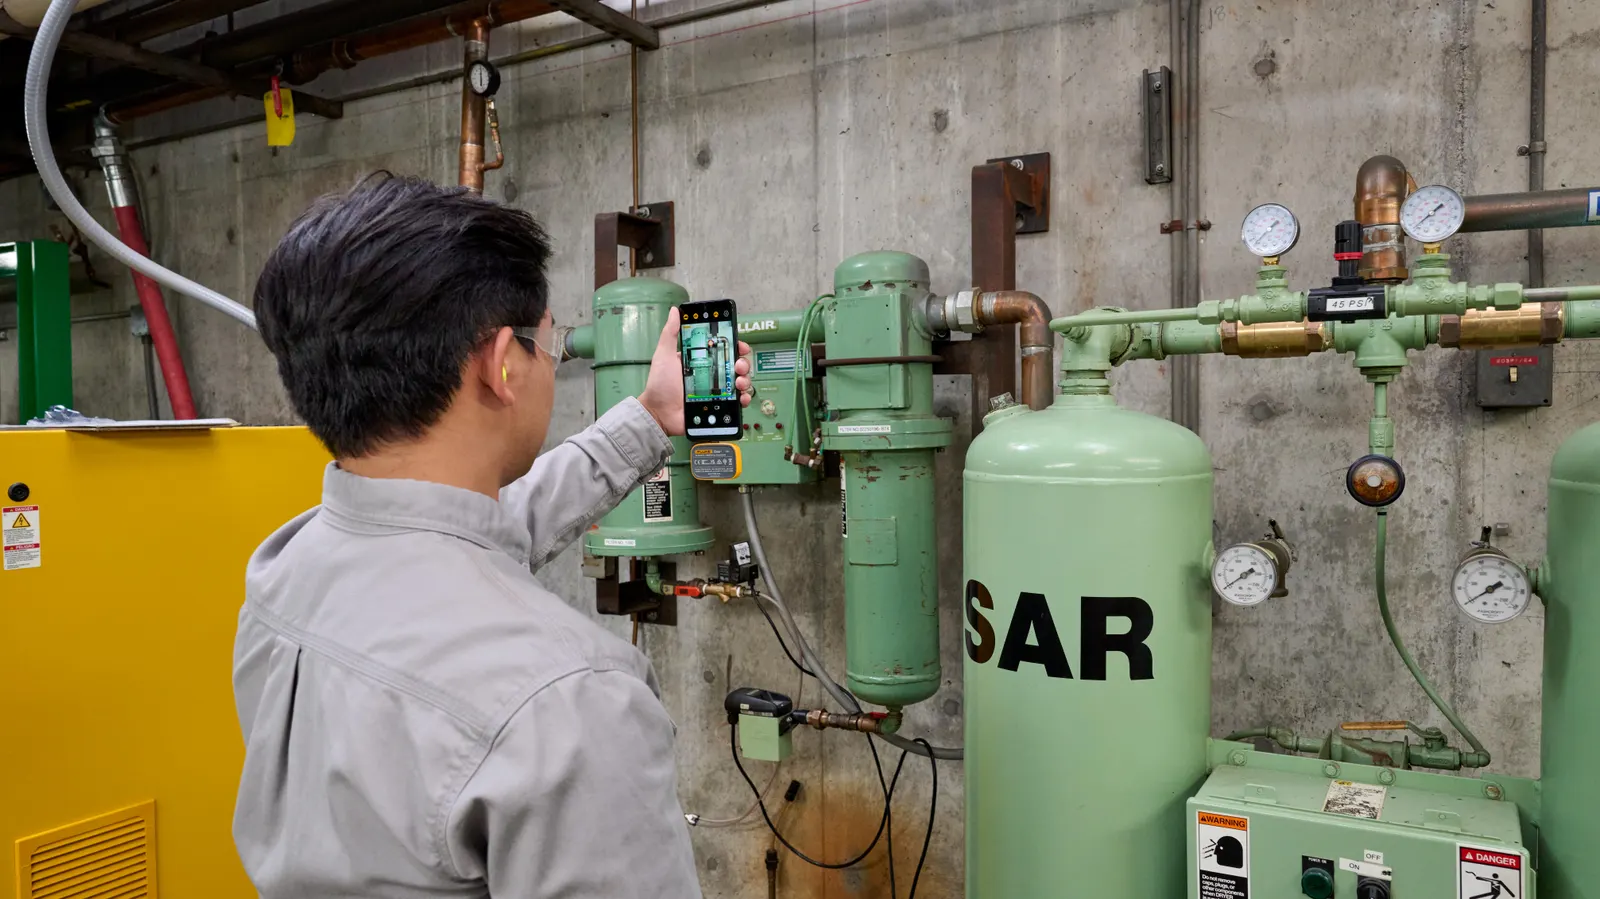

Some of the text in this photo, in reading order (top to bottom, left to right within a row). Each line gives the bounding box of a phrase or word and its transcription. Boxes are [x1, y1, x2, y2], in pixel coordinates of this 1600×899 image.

[737, 320, 777, 333] LLAIR
[965, 579, 1154, 681] SAR
[1206, 816, 1246, 828] WARNING
[1476, 853, 1516, 866] DANGER
[1215, 887, 1245, 897] components
